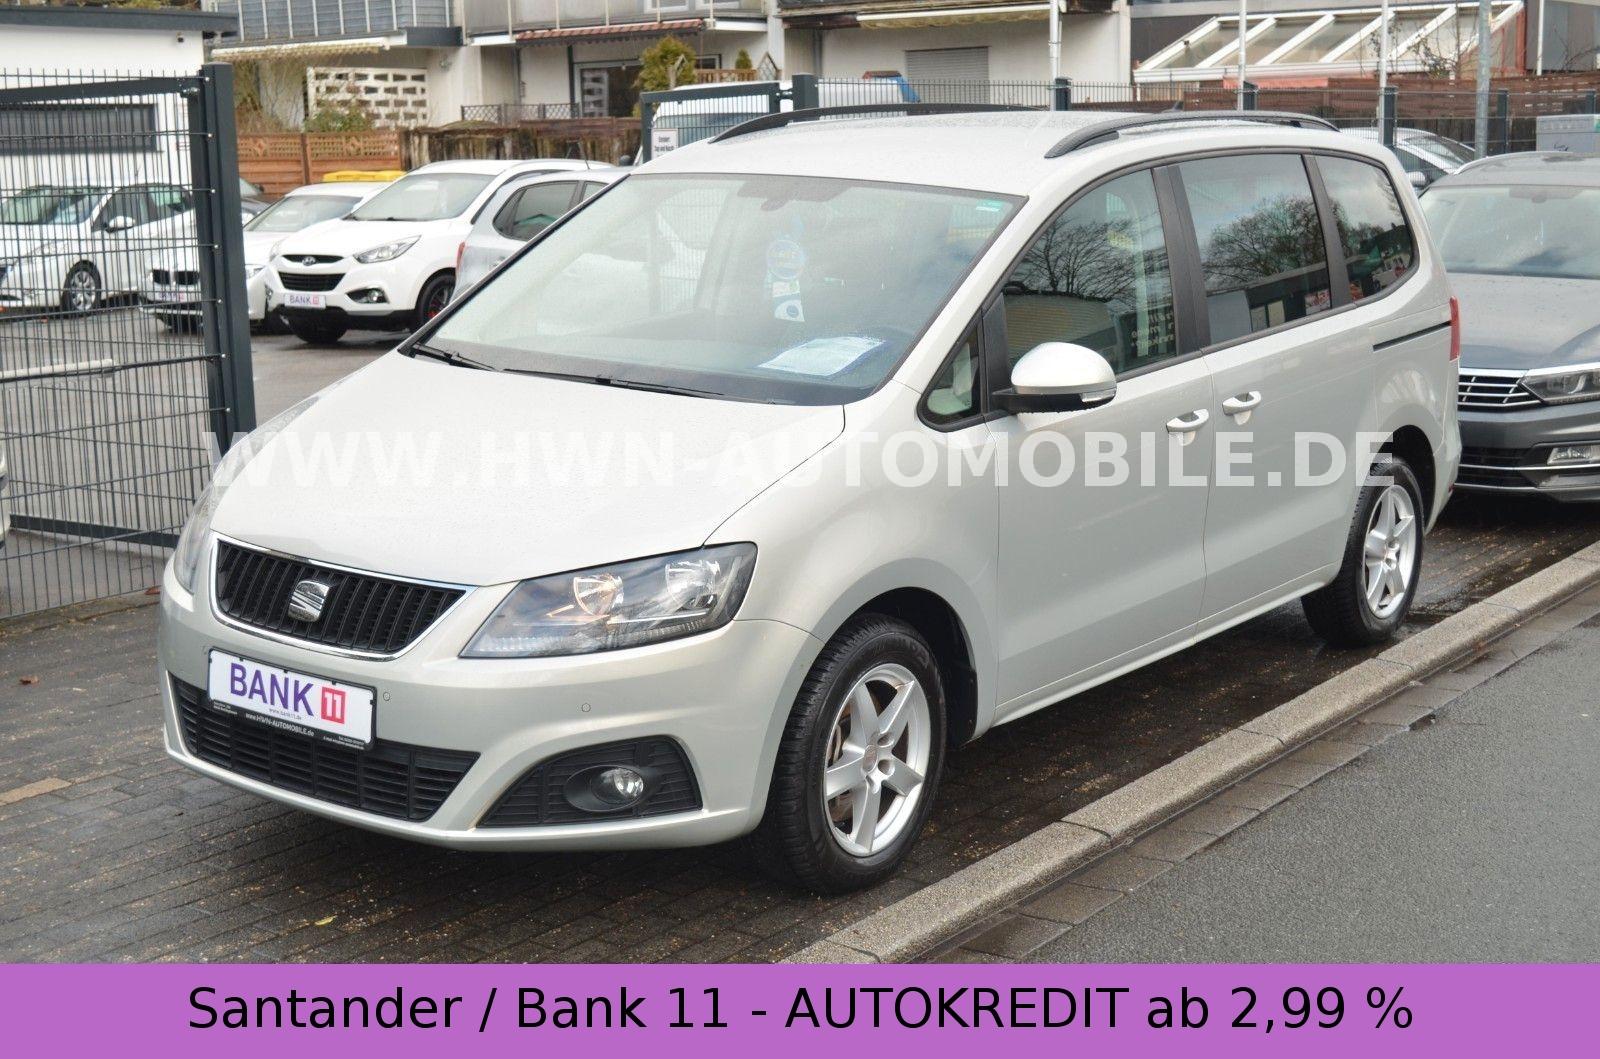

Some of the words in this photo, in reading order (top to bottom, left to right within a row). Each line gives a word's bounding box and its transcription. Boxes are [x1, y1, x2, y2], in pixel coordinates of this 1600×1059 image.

[289, 295, 311, 304] BANK
[230, 662, 314, 717] BANK
[323, 690, 344, 722] 11
